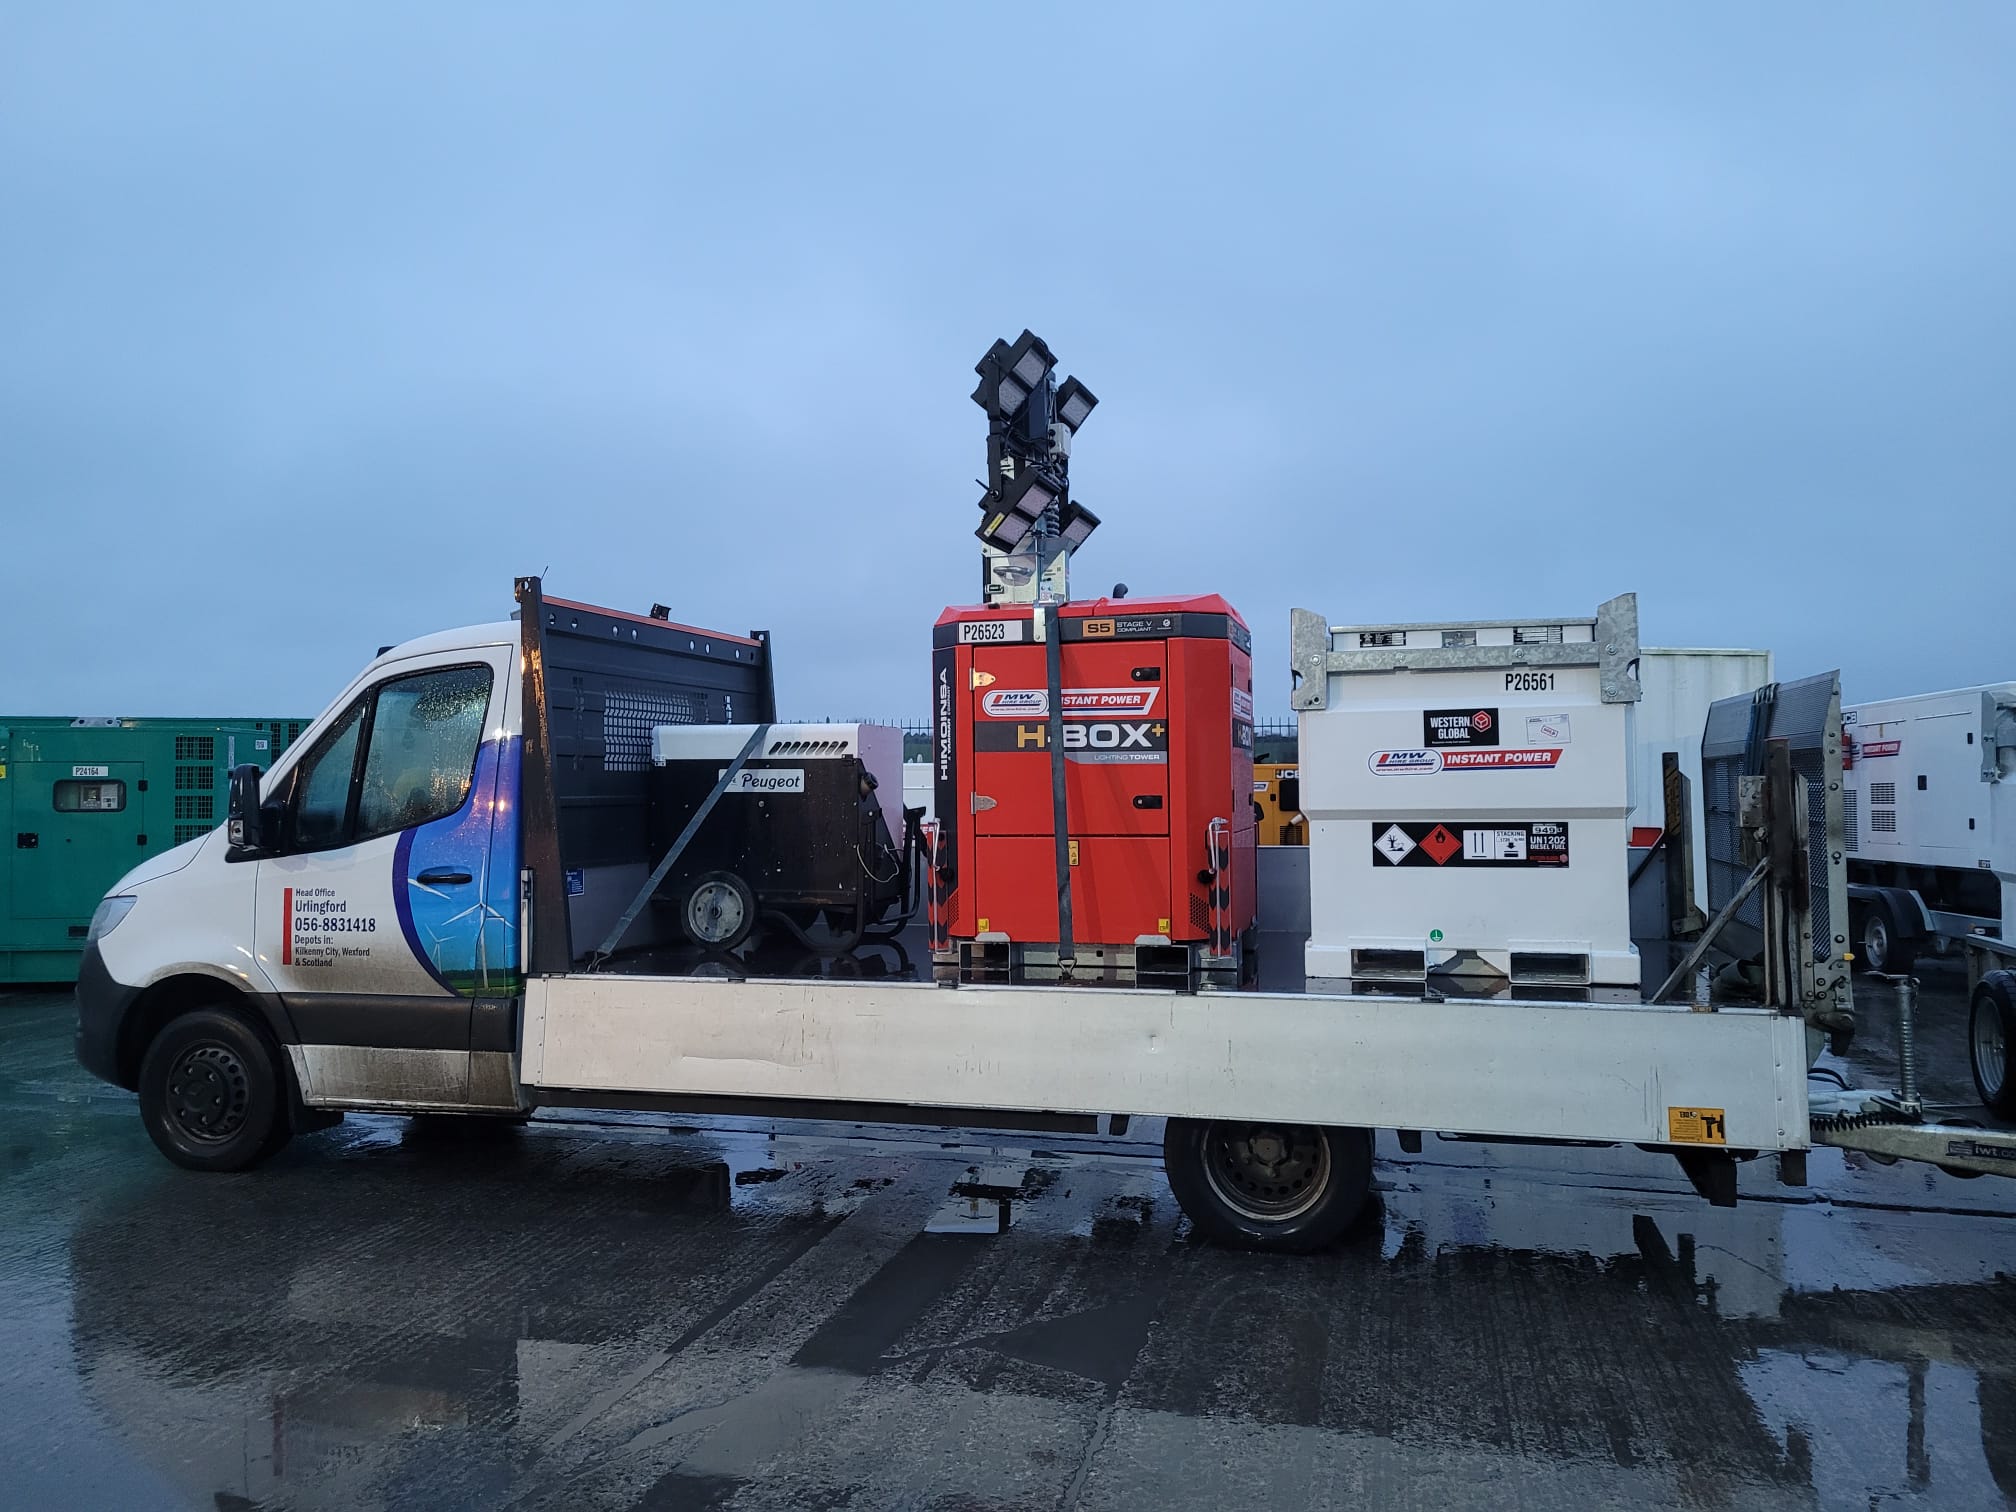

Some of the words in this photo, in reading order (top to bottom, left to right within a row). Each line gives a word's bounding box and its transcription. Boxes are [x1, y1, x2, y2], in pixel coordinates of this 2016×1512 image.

[964, 624, 1005, 640] P26523
[1087, 623, 1111, 633] S5
[1505, 673, 1555, 691] P26561
[1062, 696, 1098, 705] STANT
[1101, 695, 1141, 704] POWER
[940, 667, 948, 780] HIMOINSA
[1430, 717, 1470, 728] WESTERN
[1438, 728, 1470, 740] GLOBAL
[1447, 755, 1501, 764] INSTANT
[1505, 752, 1552, 762] POWER
[741, 773, 801, 790] Peugeot
[1530, 836, 1566, 844] UN1202
[295, 888, 314, 897] Head
[314, 888, 336, 897] Office
[295, 900, 347, 915] Urlingford
[295, 917, 376, 932] 056-8831418
[294, 934, 322, 946] Depots
[323, 934, 334, 945] in:
[295, 946, 325, 957] Kilkenny
[325, 947, 341, 958] City,
[341, 947, 370, 956] Wexford
[294, 958, 301, 967] &
[301, 958, 333, 967] Scotland
